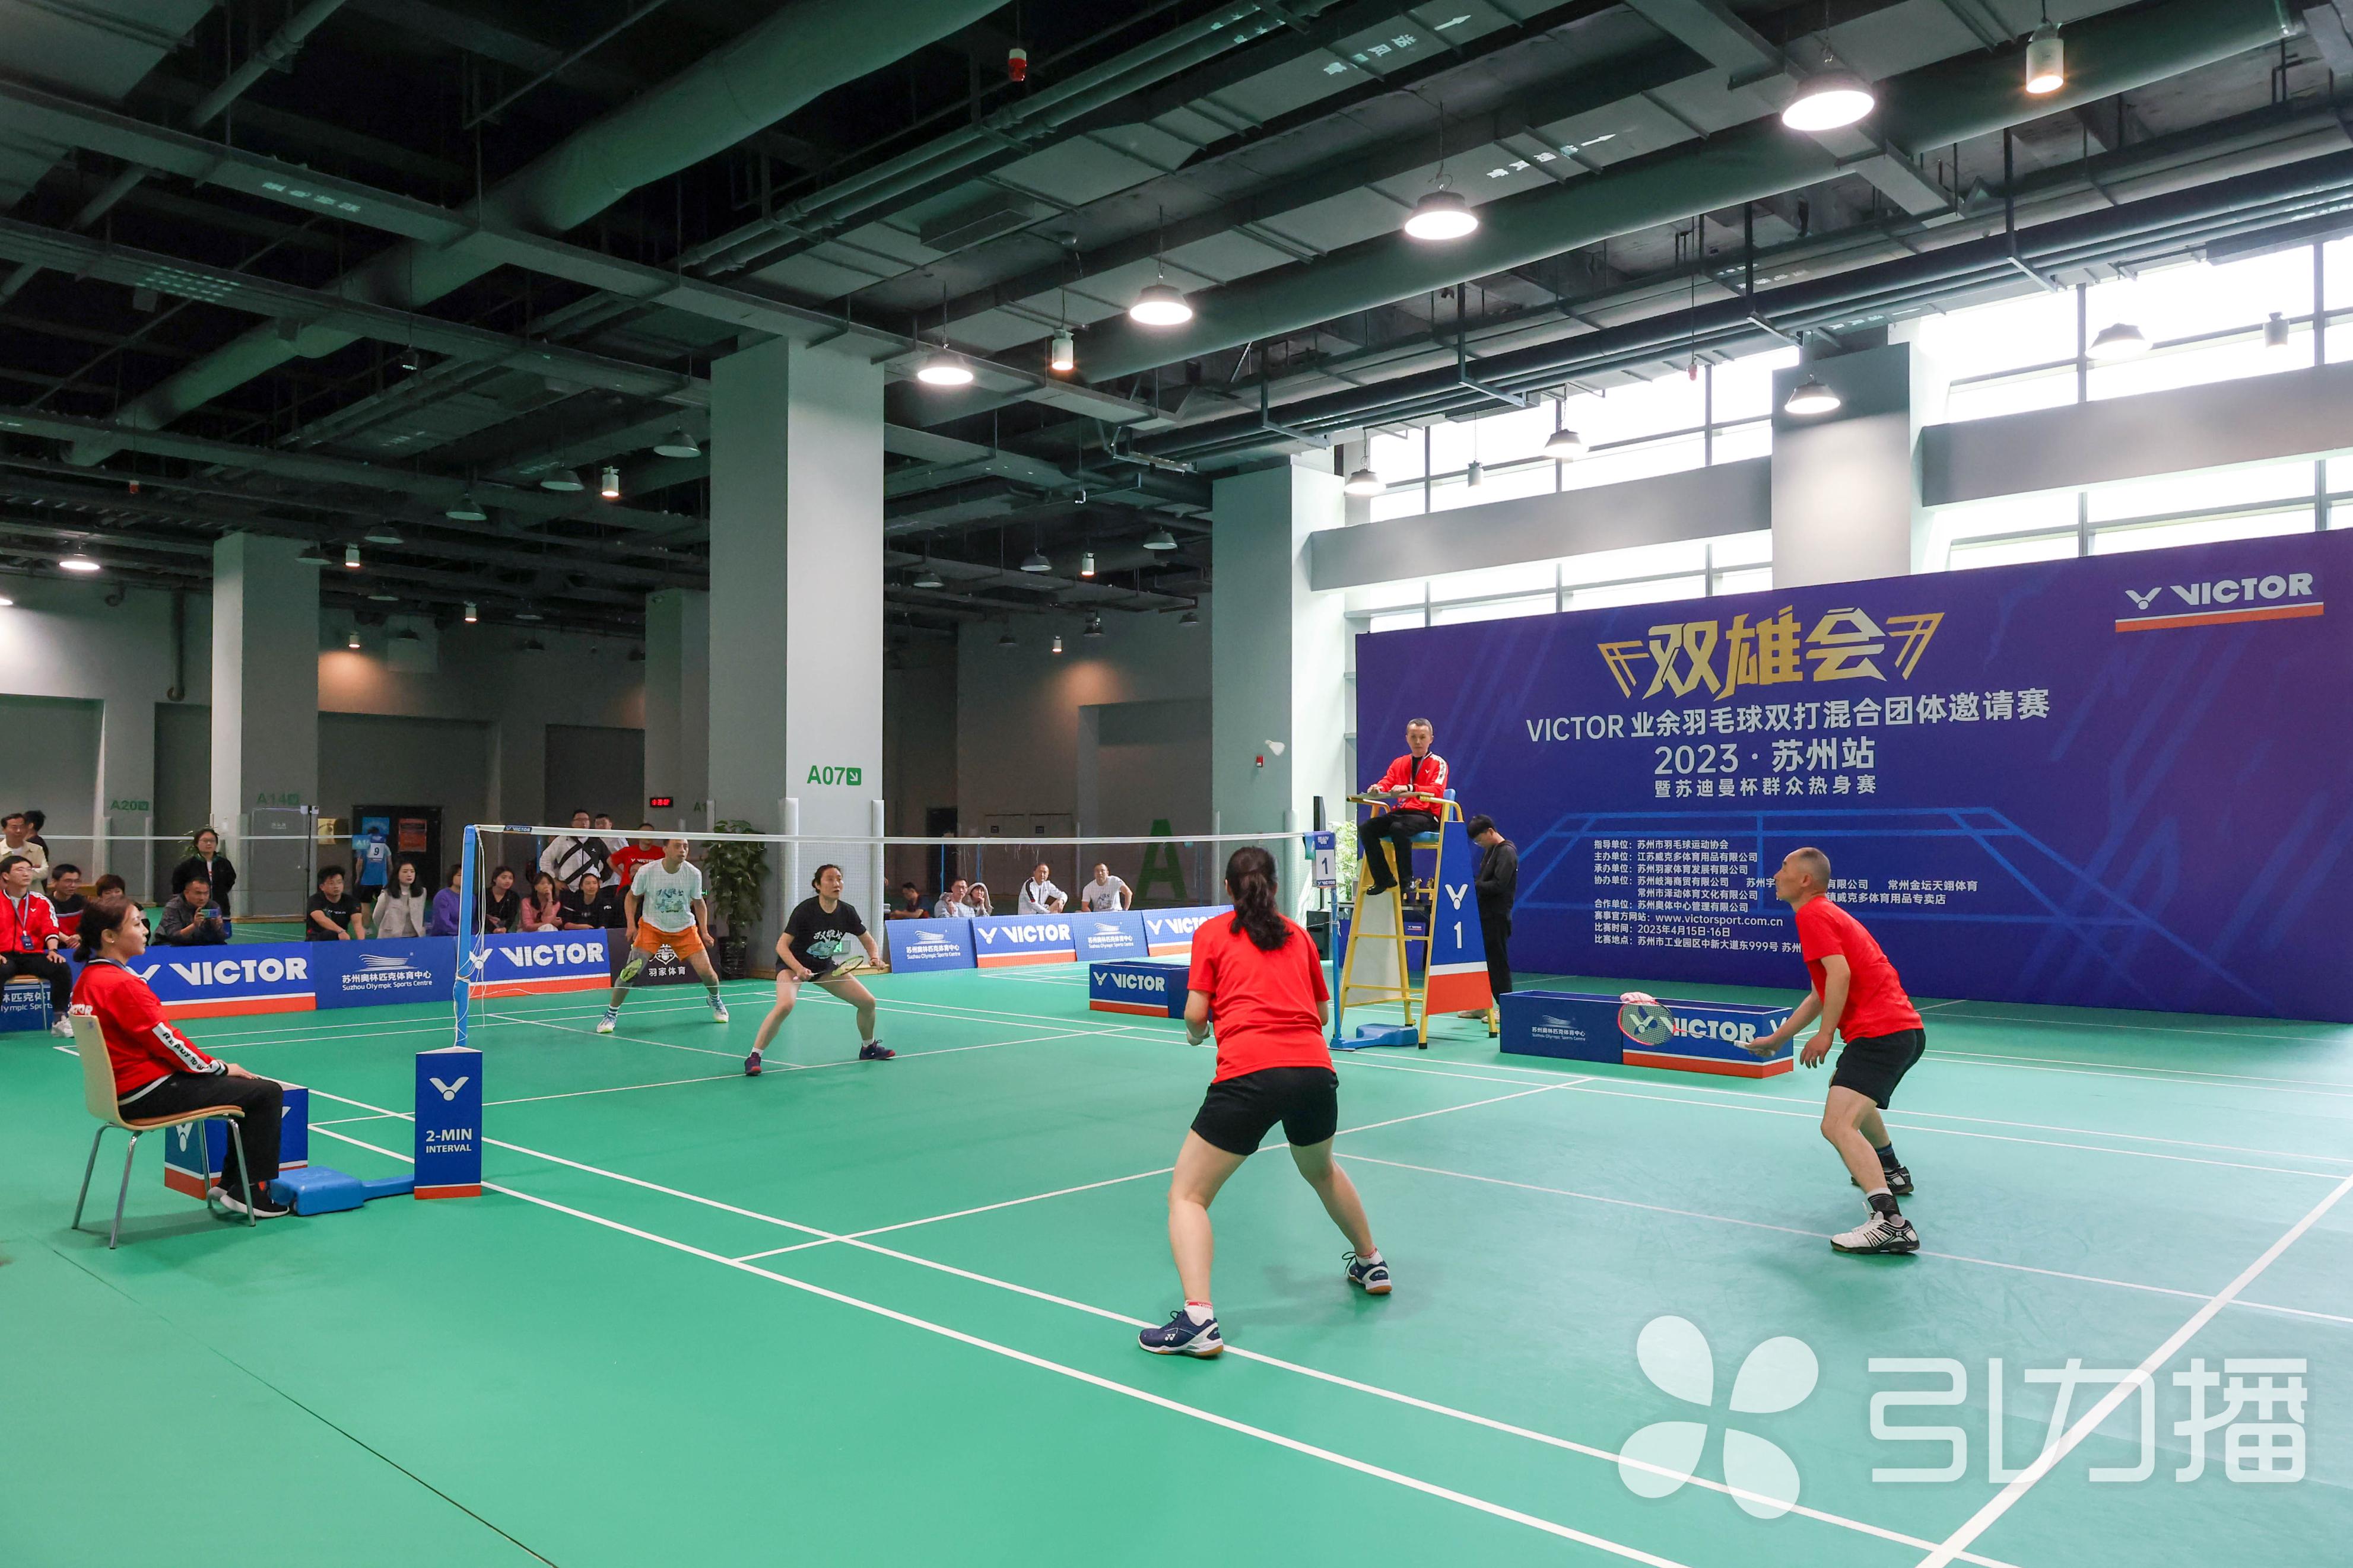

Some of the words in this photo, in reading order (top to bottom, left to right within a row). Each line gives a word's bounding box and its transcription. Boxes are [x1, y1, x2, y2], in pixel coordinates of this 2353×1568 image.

[2170, 573, 2313, 606] VICTOR
[1642, 605, 1888, 701] 双雄会
[1526, 715, 1624, 743] VICTOR
[1631, 688, 2050, 739] 业余羽毛球双打混合团体邀请赛
[807, 765, 846, 785] A07
[1654, 774, 1877, 799] 暨苏迪曼杯群众热身赛
[374, 847, 380, 855] 9
[1637, 839, 1729, 850] 苏州市羽毛球运动协会
[1322, 857, 1328, 874] 1
[1637, 852, 1758, 862] 江苏威克多体育用品有限公司
[1637, 864, 1748, 875] 苏州羽家体育发展有限公司
[1637, 901, 1748, 912] 苏州奥体中心管理有限公司
[1165, 917, 1214, 934] VICT
[1655, 914, 1783, 927] www.victorsport.com.cn
[1002, 924, 1071, 943] VICTOR
[1453, 921, 1462, 949] 1
[1637, 924, 1730, 937] 2023年4月15日-16日
[1637, 936, 1779, 952] 苏州市工业园区中新大道东999号
[501, 942, 605, 968] VICTOR
[169, 957, 308, 985] VICTOR
[341, 971, 432, 984] 苏州奥林匹克体育中心
[649, 966, 686, 977] 羽家体育
[1111, 972, 1165, 992] VICTOR
[1659, 1015, 1757, 1043] VICTOR
[425, 1128, 473, 1143] 2-MIN
[425, 1144, 472, 1153] INTERVAL
